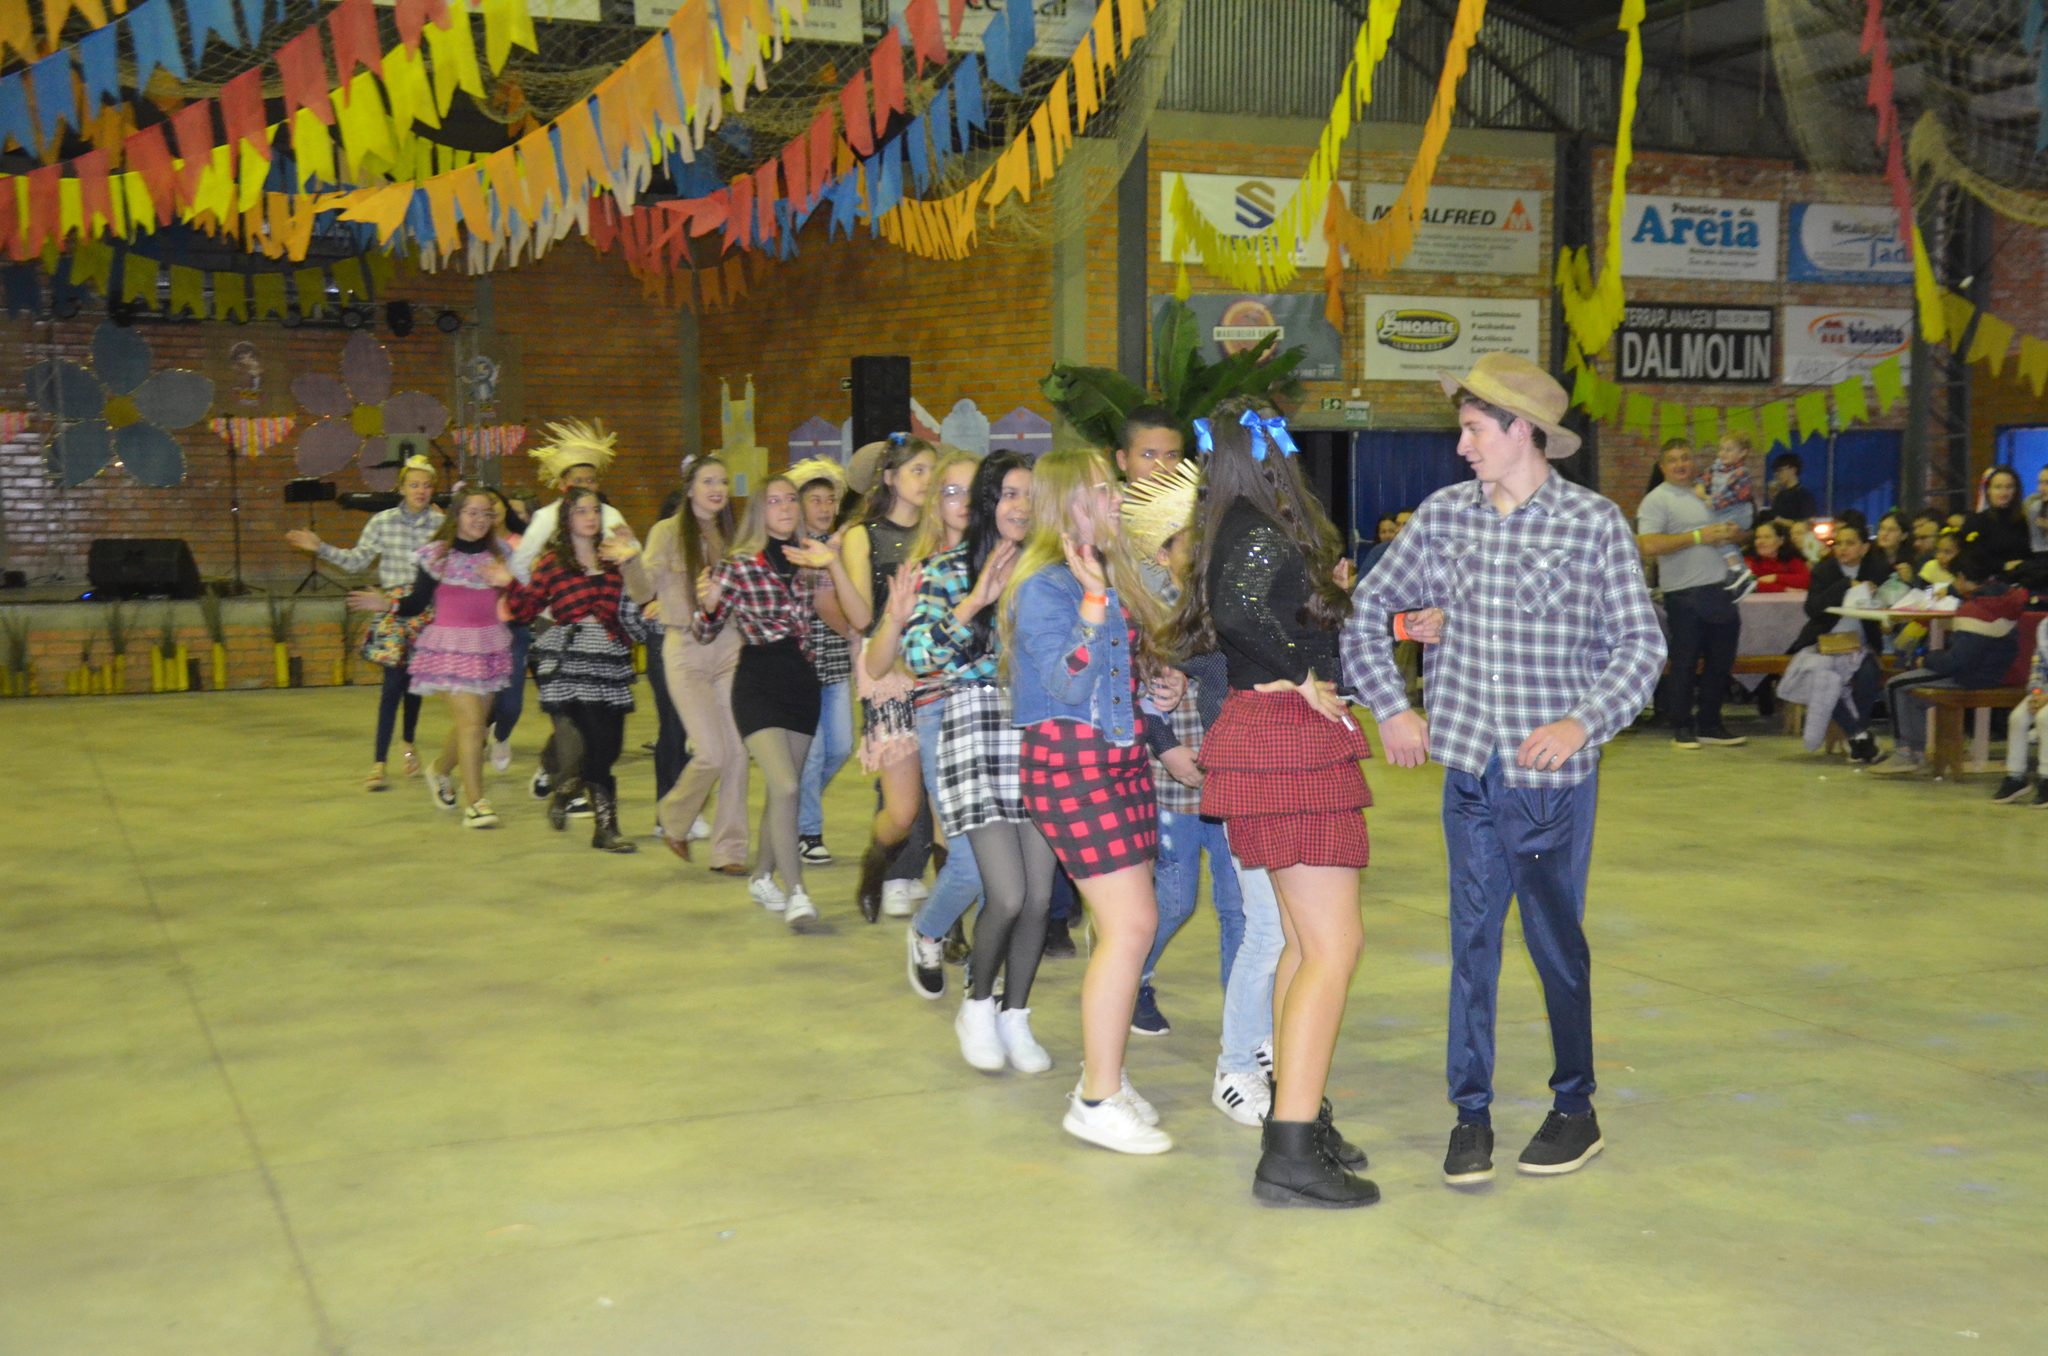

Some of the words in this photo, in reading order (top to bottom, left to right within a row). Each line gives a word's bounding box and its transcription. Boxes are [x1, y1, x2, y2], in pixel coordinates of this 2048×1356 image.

[1372, 204, 1497, 226] MALFRED
[1631, 203, 1760, 248] Areia
[1622, 331, 1772, 379] DALMOLIN
